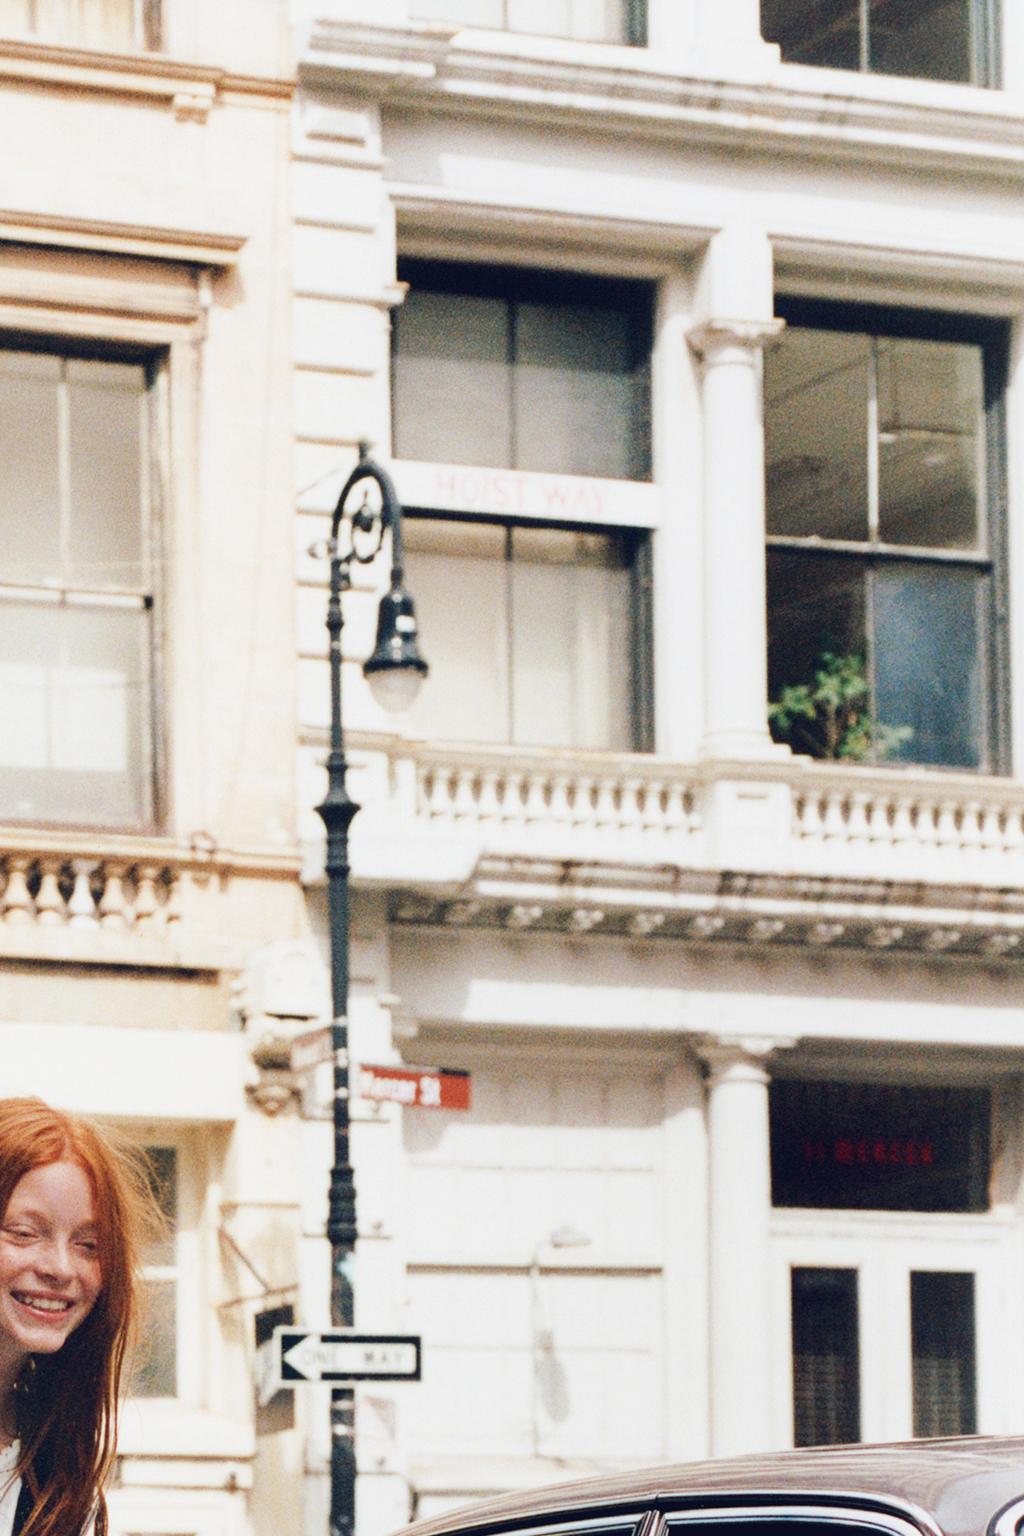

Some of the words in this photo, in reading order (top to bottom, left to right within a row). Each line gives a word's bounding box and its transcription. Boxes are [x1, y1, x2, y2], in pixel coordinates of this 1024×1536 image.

[434, 473, 528, 508] HOIST
[542, 480, 609, 515] WAY
[419, 1075, 441, 1106] St
